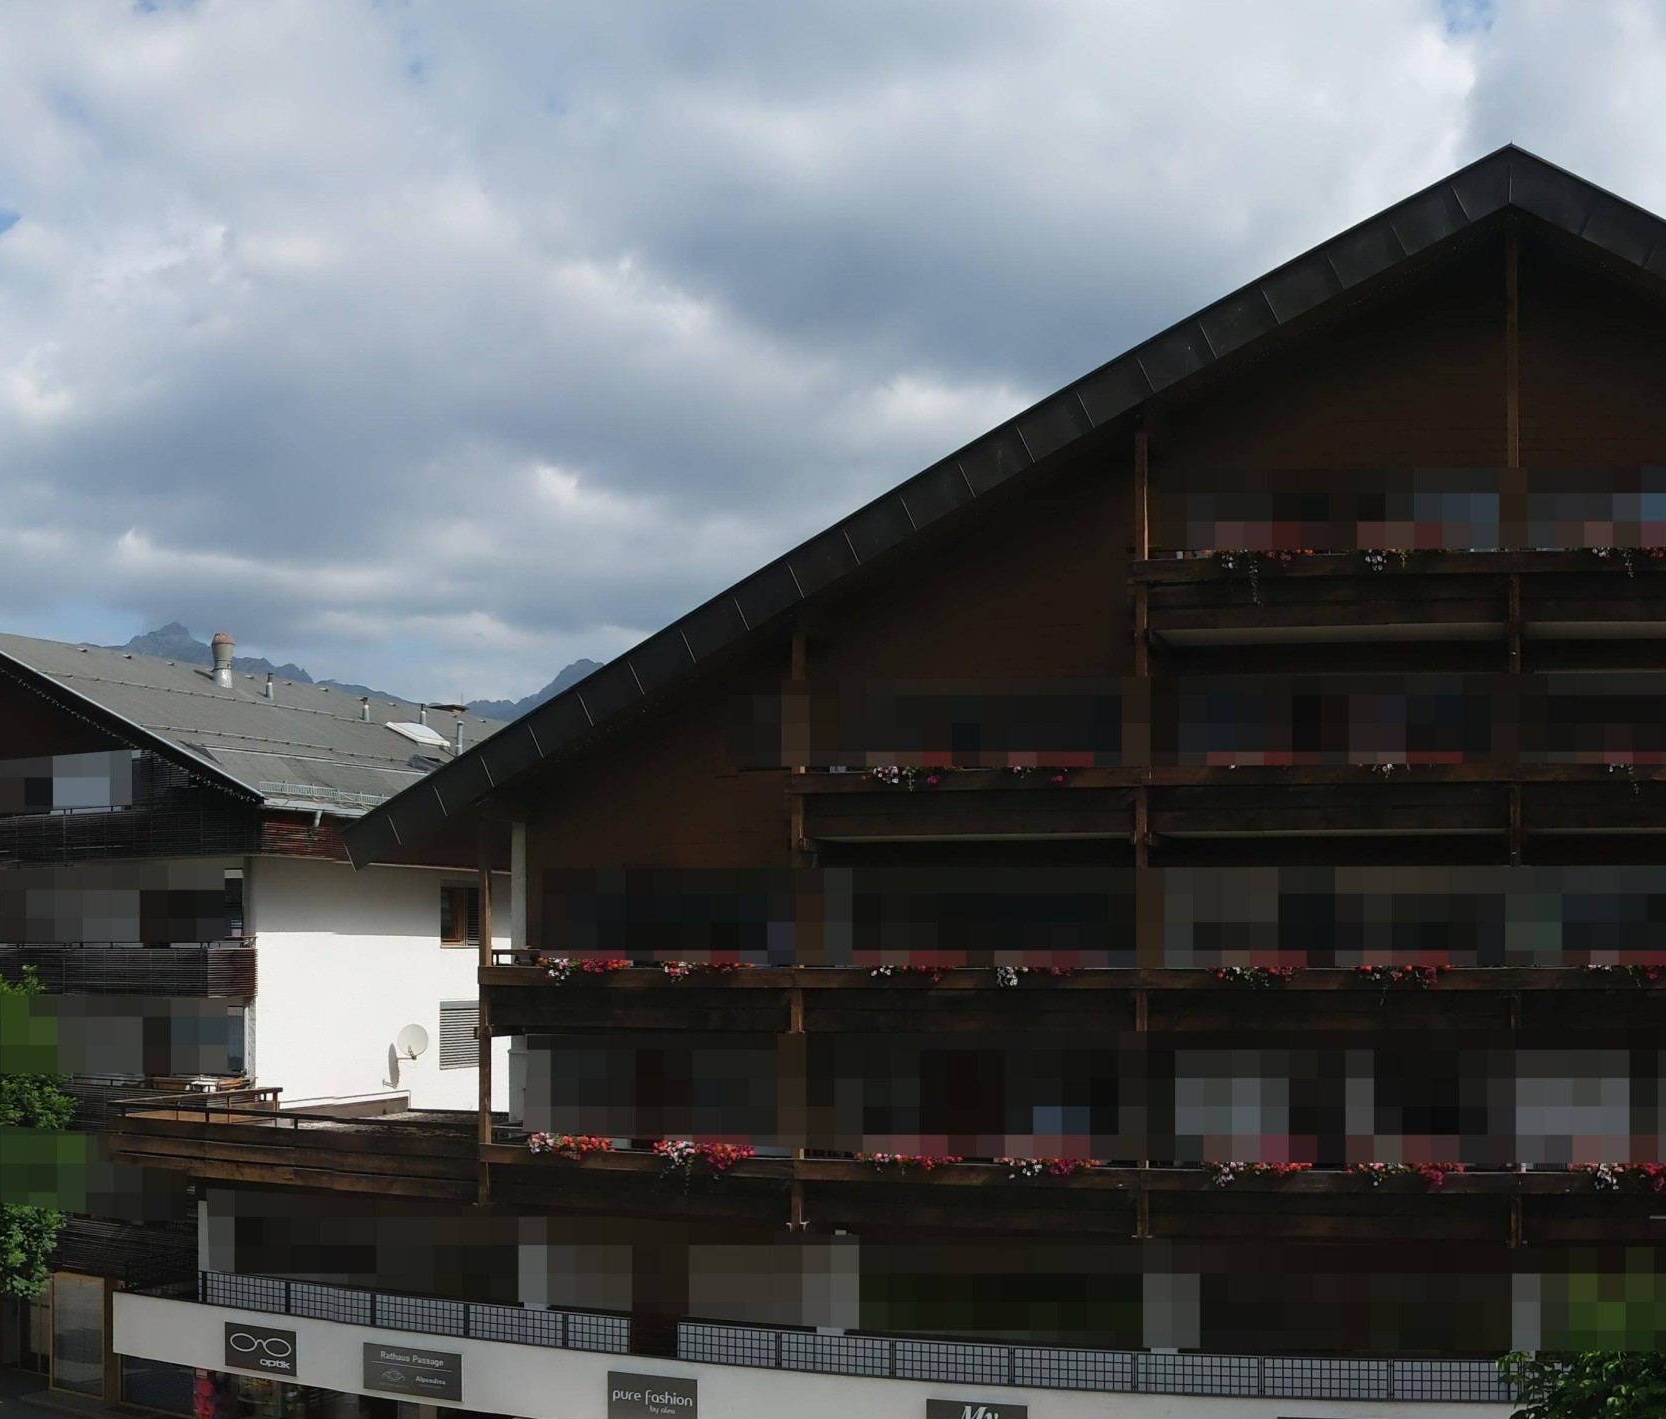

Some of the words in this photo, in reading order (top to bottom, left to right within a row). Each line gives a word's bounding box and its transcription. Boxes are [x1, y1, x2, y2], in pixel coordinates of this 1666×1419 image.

[259, 1358, 291, 1370] optik
[380, 1350, 410, 1363] Rathaus
[412, 1354, 444, 1368] Passage
[612, 1389, 642, 1402] pure
[645, 1389, 693, 1407] fashion
[649, 1405, 659, 1415] by
